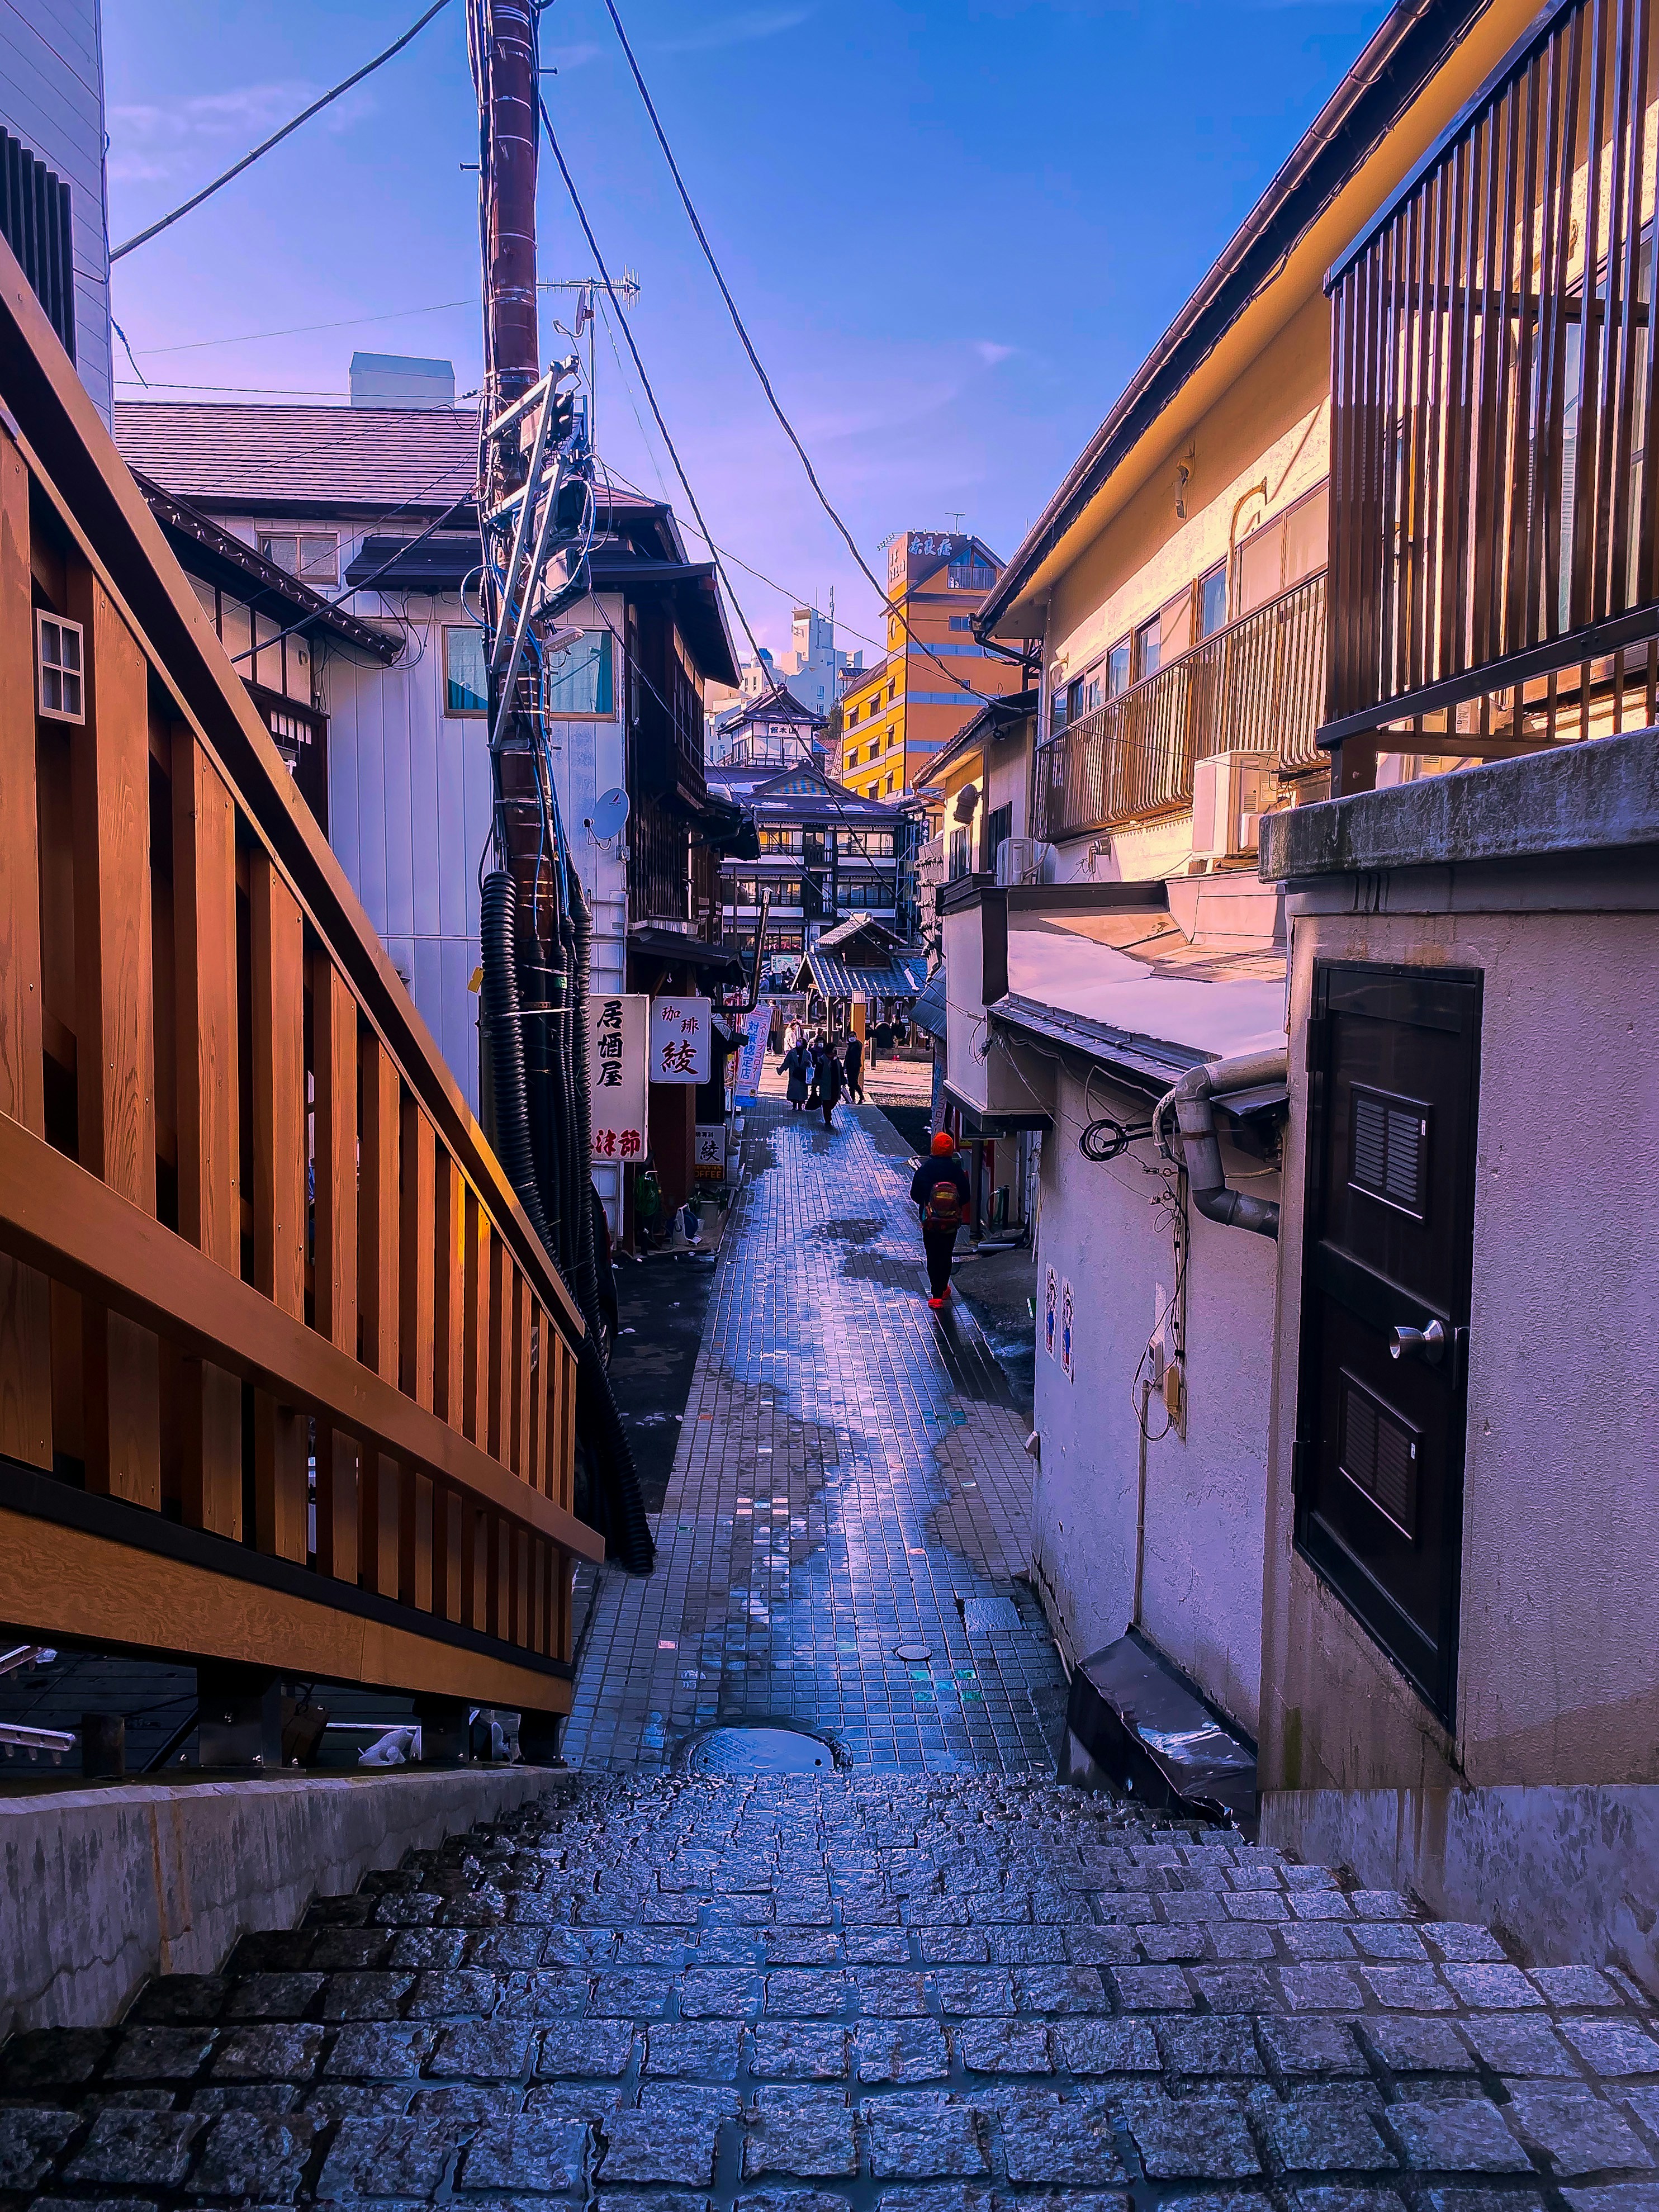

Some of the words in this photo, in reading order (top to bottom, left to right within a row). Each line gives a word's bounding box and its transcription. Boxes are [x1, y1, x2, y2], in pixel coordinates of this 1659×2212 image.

[661, 1006, 699, 1035] 珈琲
[596, 1000, 623, 1087] 居酒屋
[660, 1039, 699, 1075] 綾
[740, 1020, 760, 1079] 対策認定店
[590, 1129, 641, 1158] 津節
[699, 1140, 721, 1162] 綾
